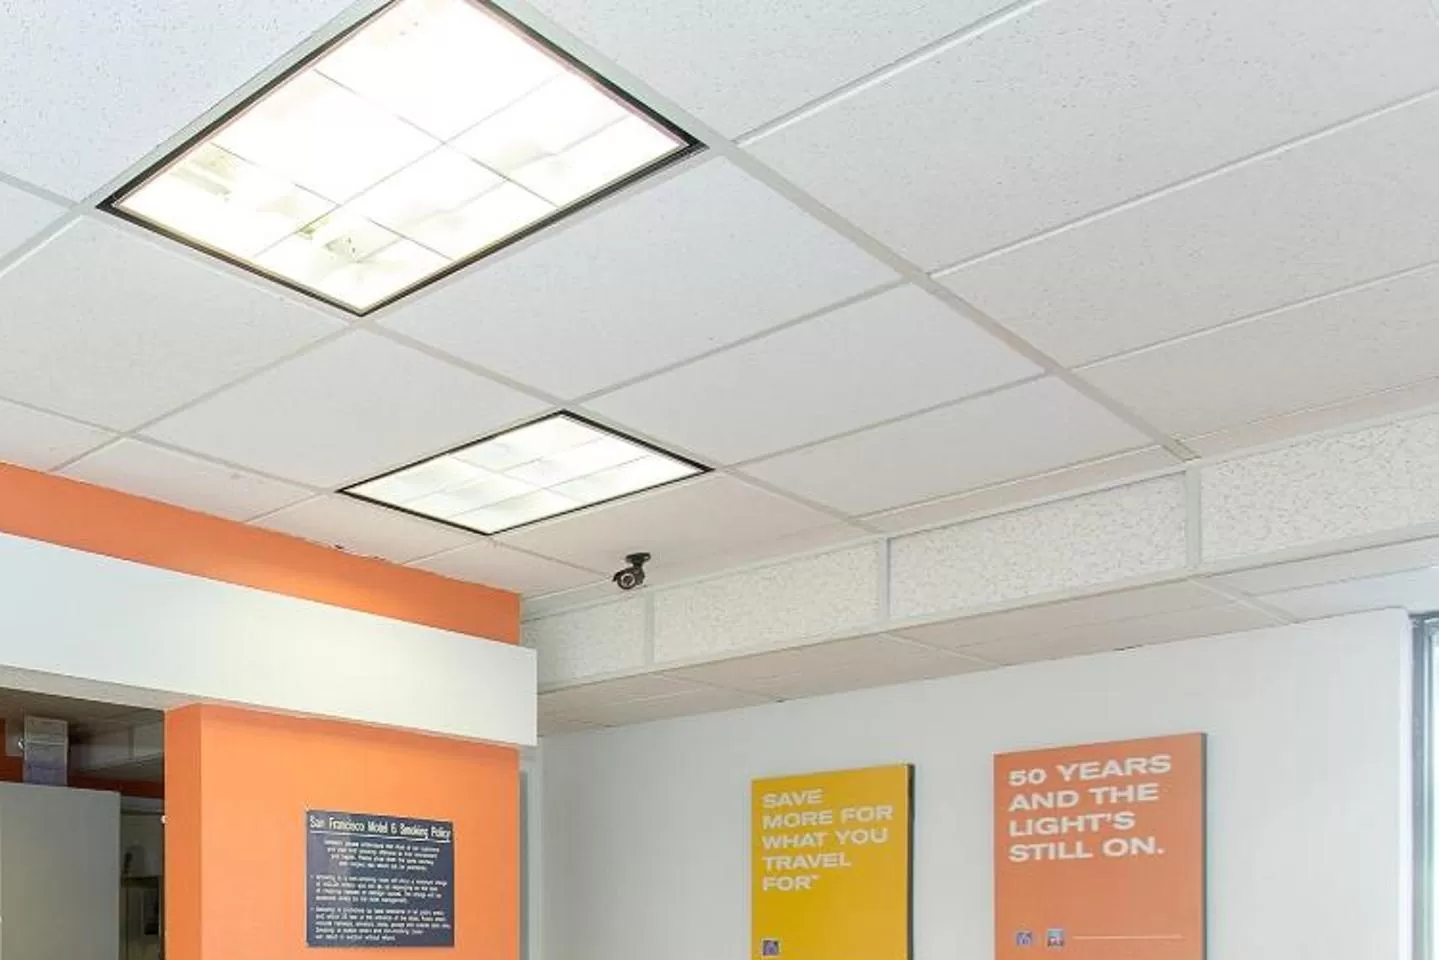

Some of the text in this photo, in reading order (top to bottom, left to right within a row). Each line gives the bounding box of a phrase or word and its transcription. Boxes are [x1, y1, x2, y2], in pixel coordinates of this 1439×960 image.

[1008, 754, 1172, 786] 50 YEARS
[763, 788, 823, 808] SAVE
[1008, 783, 1160, 812] AND THE
[310, 815, 451, 842] San Francisco Motel 6 Smoking Policy
[763, 805, 894, 830] MORE FOR
[1008, 811, 1136, 837] LIGHT'S
[762, 828, 889, 849] WHAT YOU
[1008, 836, 1165, 862] STILL ON.
[762, 852, 852, 871] TRAVEL
